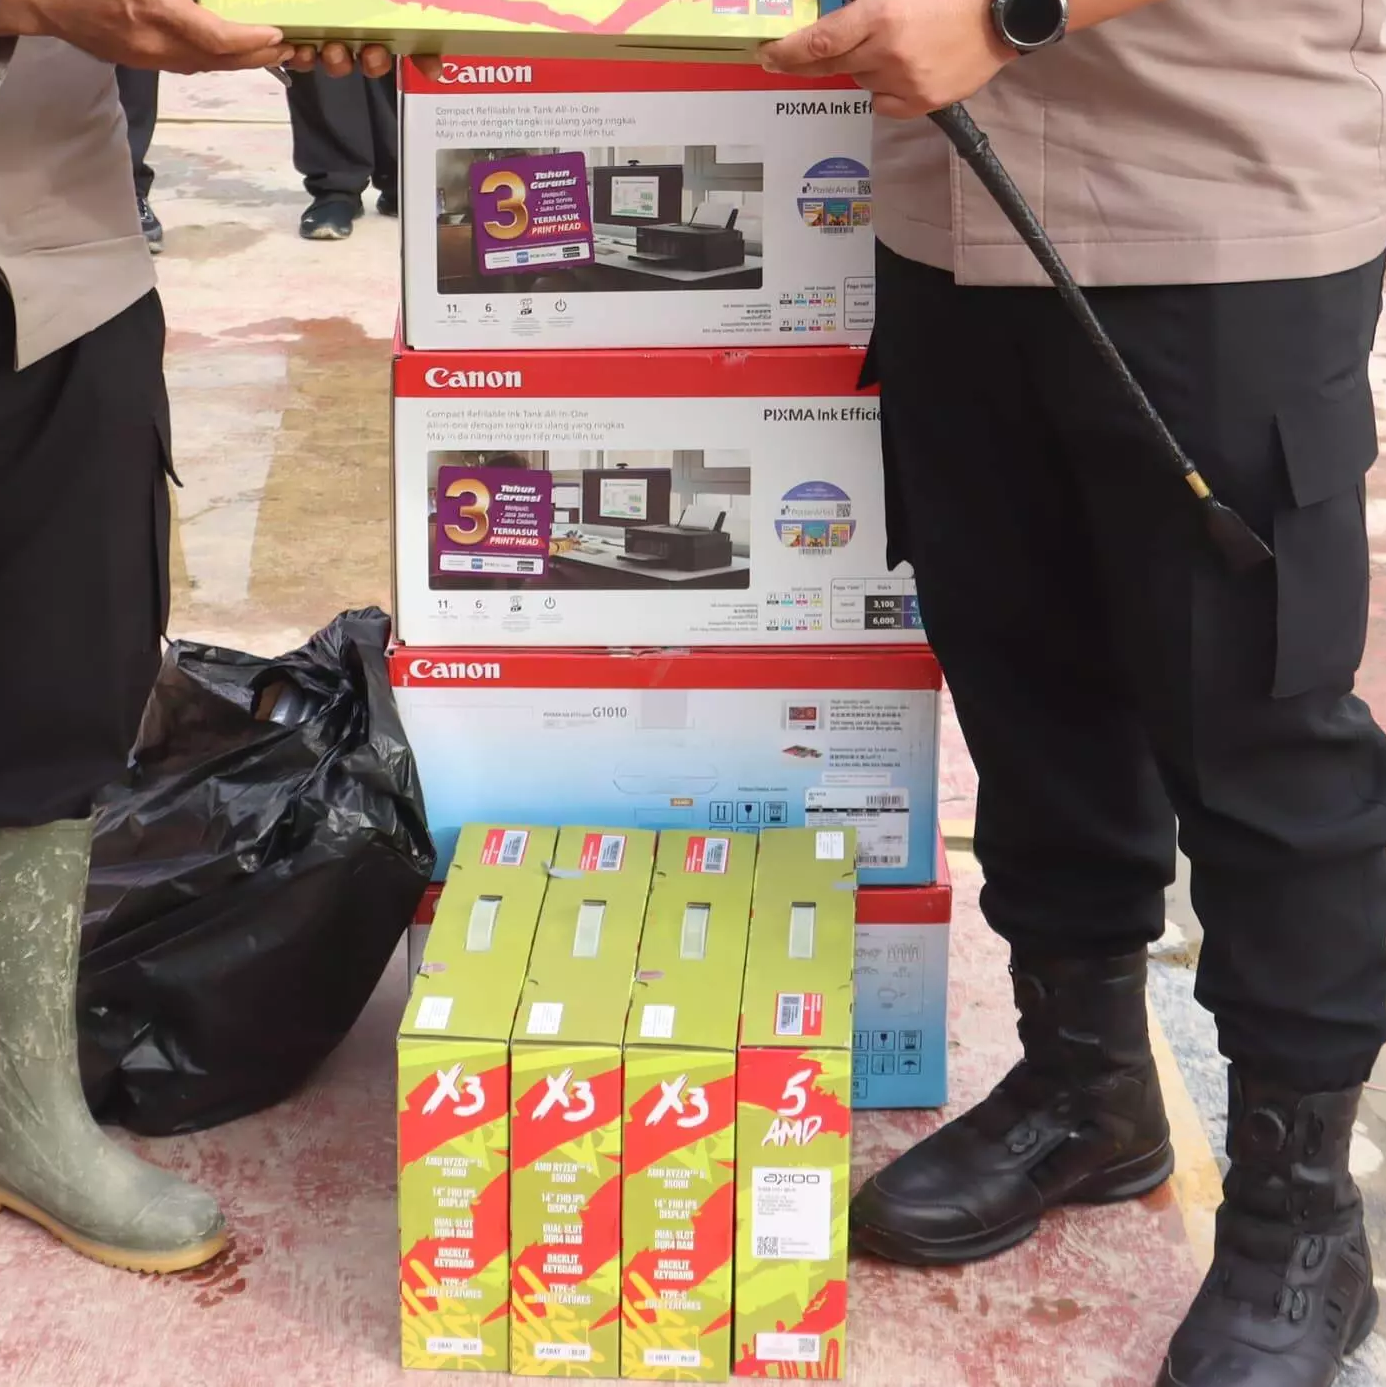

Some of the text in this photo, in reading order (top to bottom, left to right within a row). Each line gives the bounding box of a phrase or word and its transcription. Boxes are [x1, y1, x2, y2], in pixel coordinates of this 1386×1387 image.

[437, 62, 533, 84] Canon
[776, 102, 828, 115] PIXMA
[830, 101, 851, 115] Ink
[534, 169, 570, 180] Tahun
[530, 177, 577, 190] Garansi
[480, 170, 529, 240] 3
[532, 213, 580, 225] TERMASUK
[532, 222, 582, 234] PRINT HEAD
[484, 303, 492, 313] 6
[424, 367, 523, 388] Canon
[763, 408, 815, 421] PIXMA
[817, 407, 839, 421] Ink
[500, 484, 536, 494] Tahun
[494, 493, 542, 503] Garansi
[444, 478, 491, 545] 3
[492, 527, 539, 537] TERMASUK
[489, 536, 539, 546] PRINT HEAD
[409, 659, 501, 680] Canon
[592, 706, 628, 718] G1010
[421, 1062, 486, 1117] X3
[531, 1067, 596, 1122] X3
[780, 1069, 813, 1115] 5
[644, 1072, 710, 1128] X3
[760, 1115, 823, 1148] AMD
[438, 1197, 469, 1208] DISPLAY
[547, 1203, 578, 1214] DISPLAY
[433, 1257, 475, 1269] KEYBOARD
[542, 1263, 584, 1275] KEYBOARD
[653, 1269, 694, 1281] KEYBOARD
